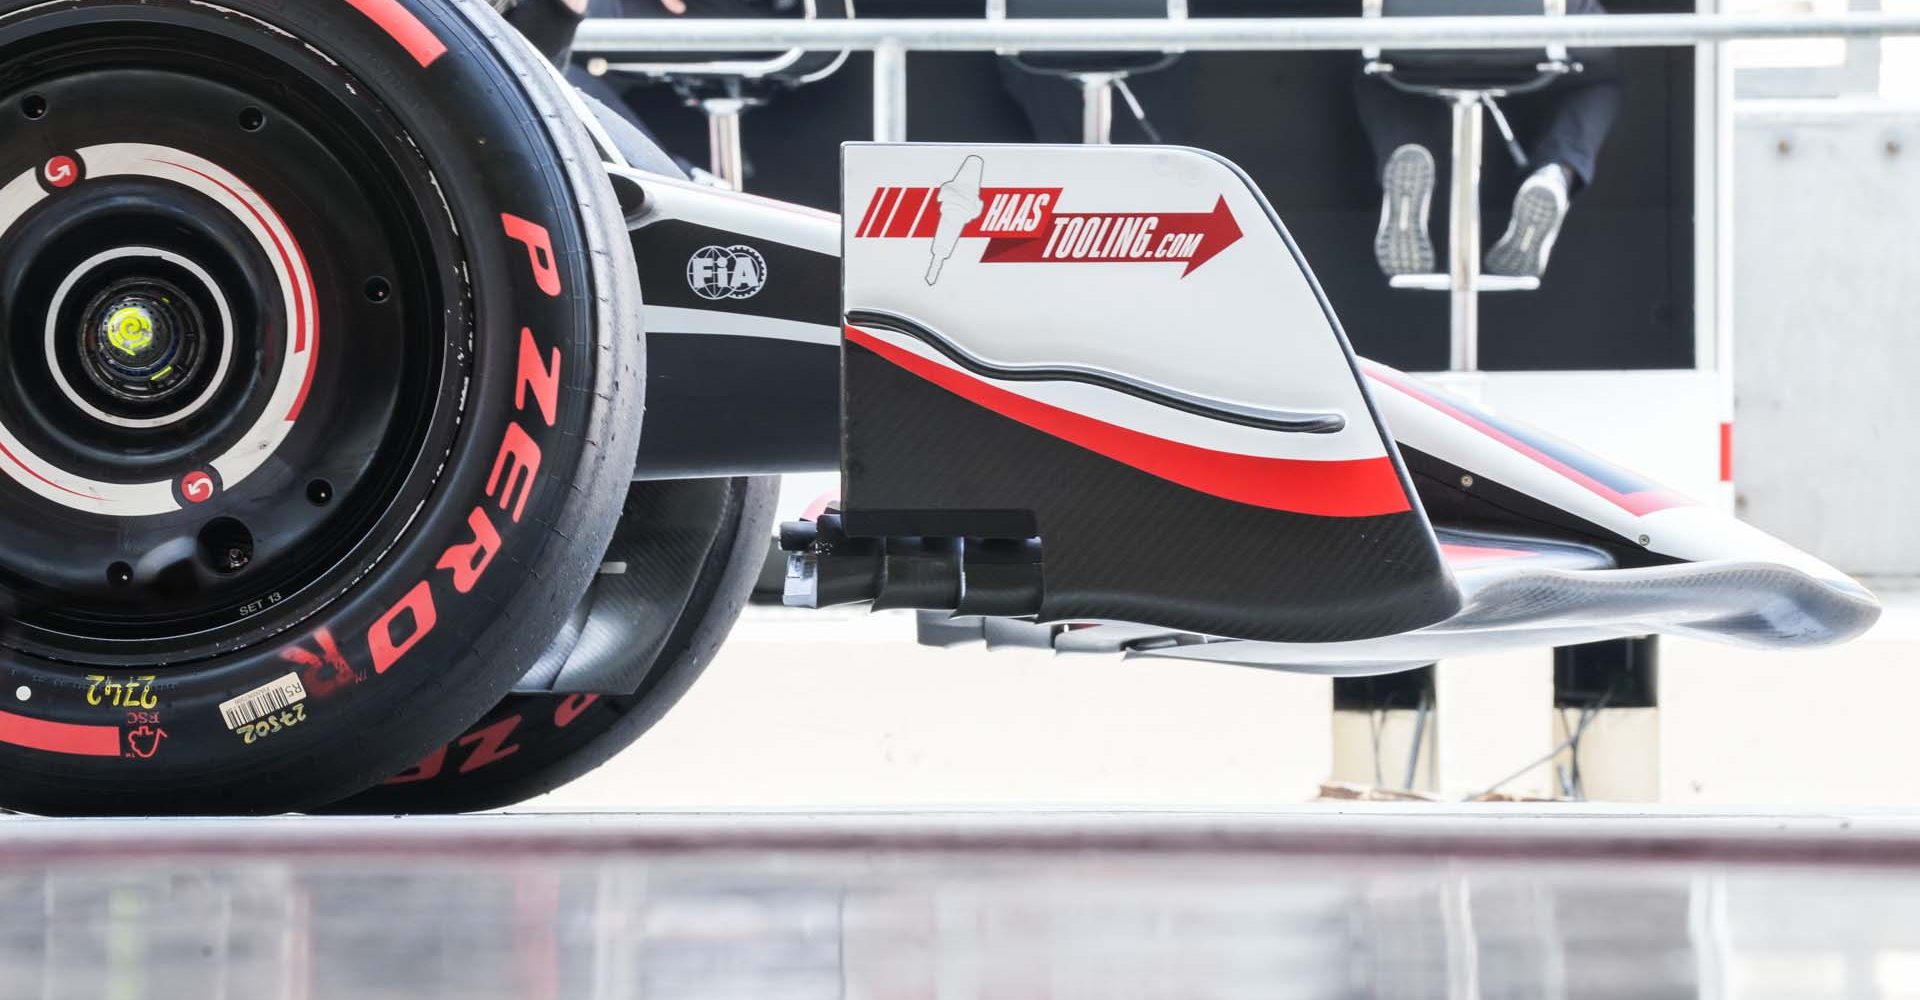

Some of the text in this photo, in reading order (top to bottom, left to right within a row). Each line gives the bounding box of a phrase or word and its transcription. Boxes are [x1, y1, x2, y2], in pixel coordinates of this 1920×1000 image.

[982, 194, 1050, 232] HAAS
[367, 212, 562, 674] P ZERO
[239, 591, 282, 616] SET 13
[85, 675, 158, 709] 2742
[127, 711, 161, 724] FSC
[236, 702, 307, 745] 27502
